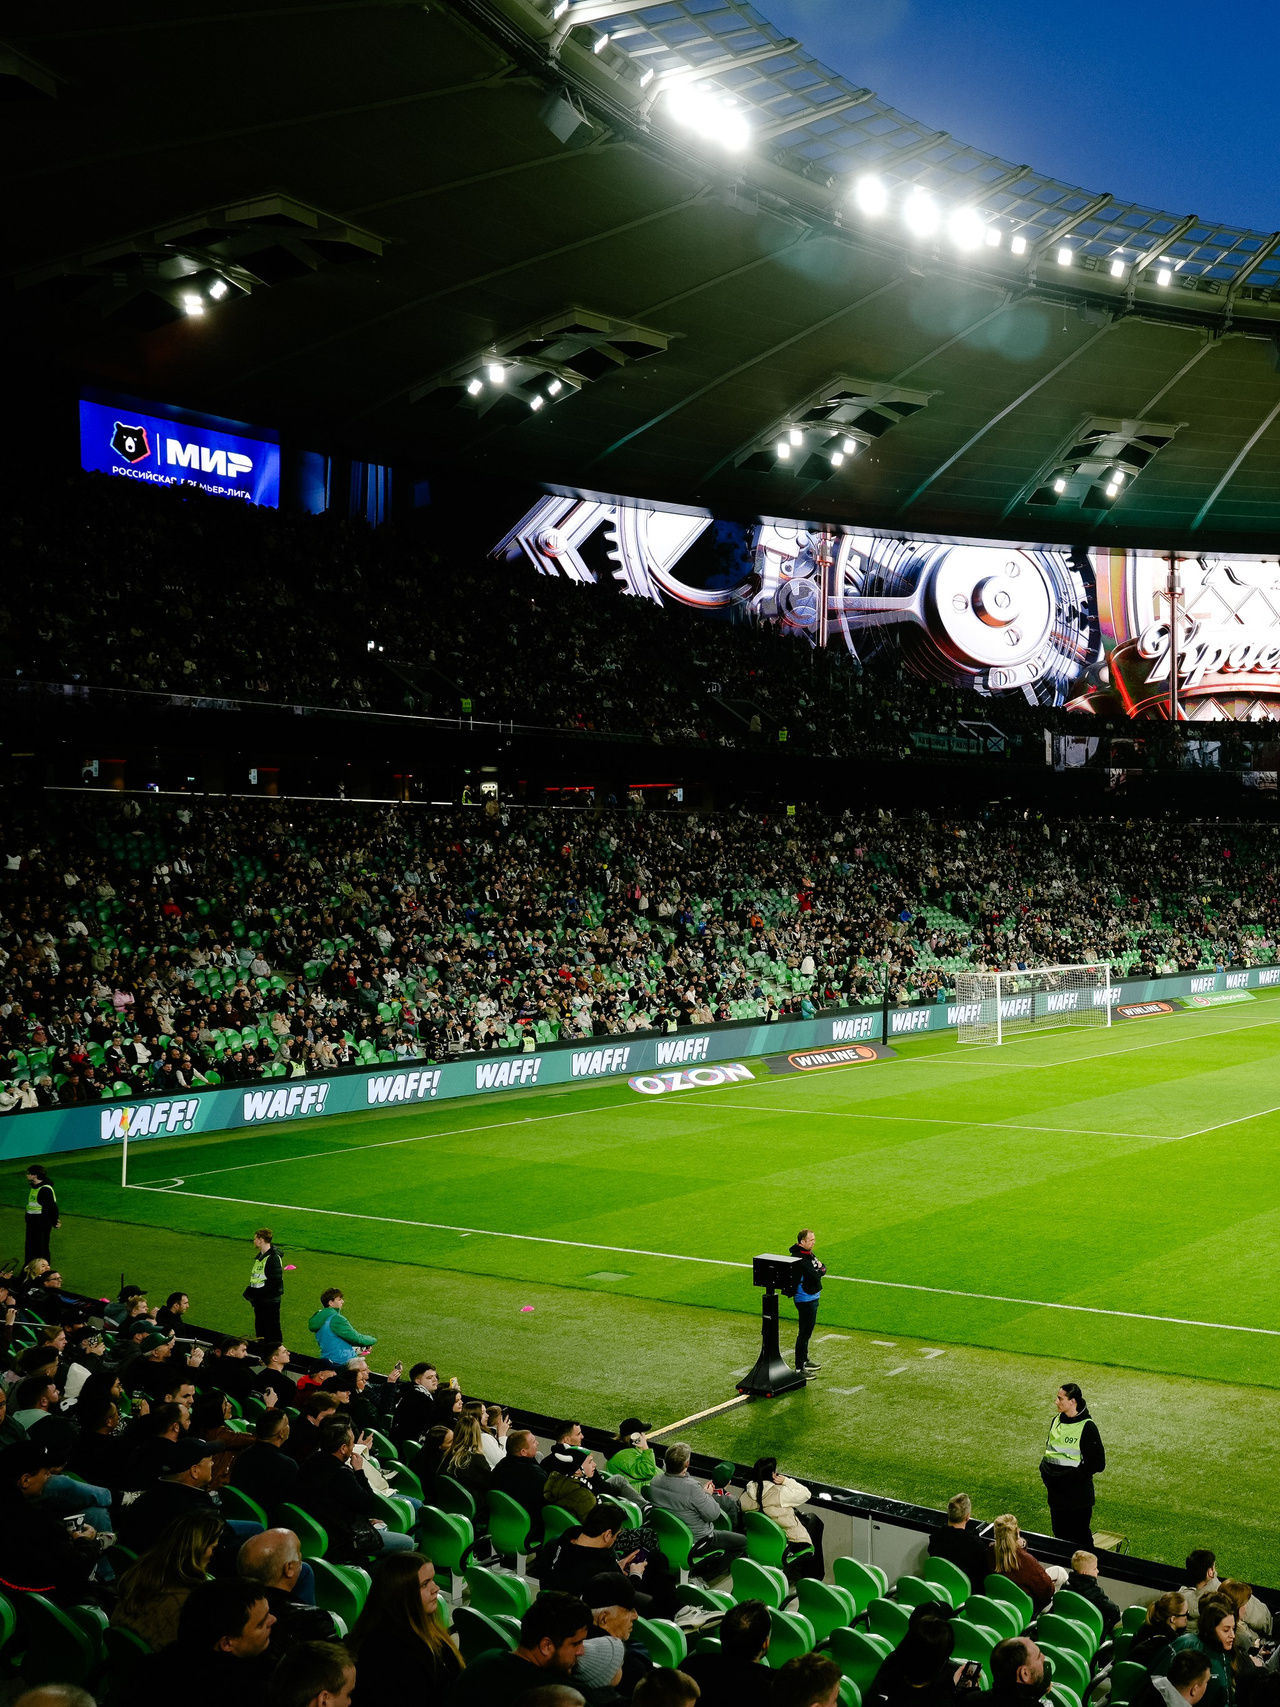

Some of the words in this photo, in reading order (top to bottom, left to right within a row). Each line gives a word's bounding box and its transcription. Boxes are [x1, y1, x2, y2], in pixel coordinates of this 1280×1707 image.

[166, 438, 253, 478] МИР
[1190, 976, 1216, 993] WAFF!
[1226, 973, 1250, 989] WAFF!
[1258, 969, 1280, 985] WAFF!
[892, 1009, 930, 1032] WAFF!
[947, 1004, 981, 1024] WAFF!
[1122, 1004, 1162, 1016] WINLINE
[832, 1016, 873, 1041] WAFF!
[572, 1047, 631, 1076] WAFF!
[657, 1037, 710, 1065] WAFF!
[796, 1049, 858, 1067] WINLINE
[476, 1057, 542, 1090] WAFF!
[629, 1063, 755, 1094] OZON
[368, 1070, 442, 1104] WAFF!
[244, 1084, 328, 1121] WAFF!
[101, 1099, 198, 1142] WAFF!
[1065, 1436, 1078, 1445] 097
